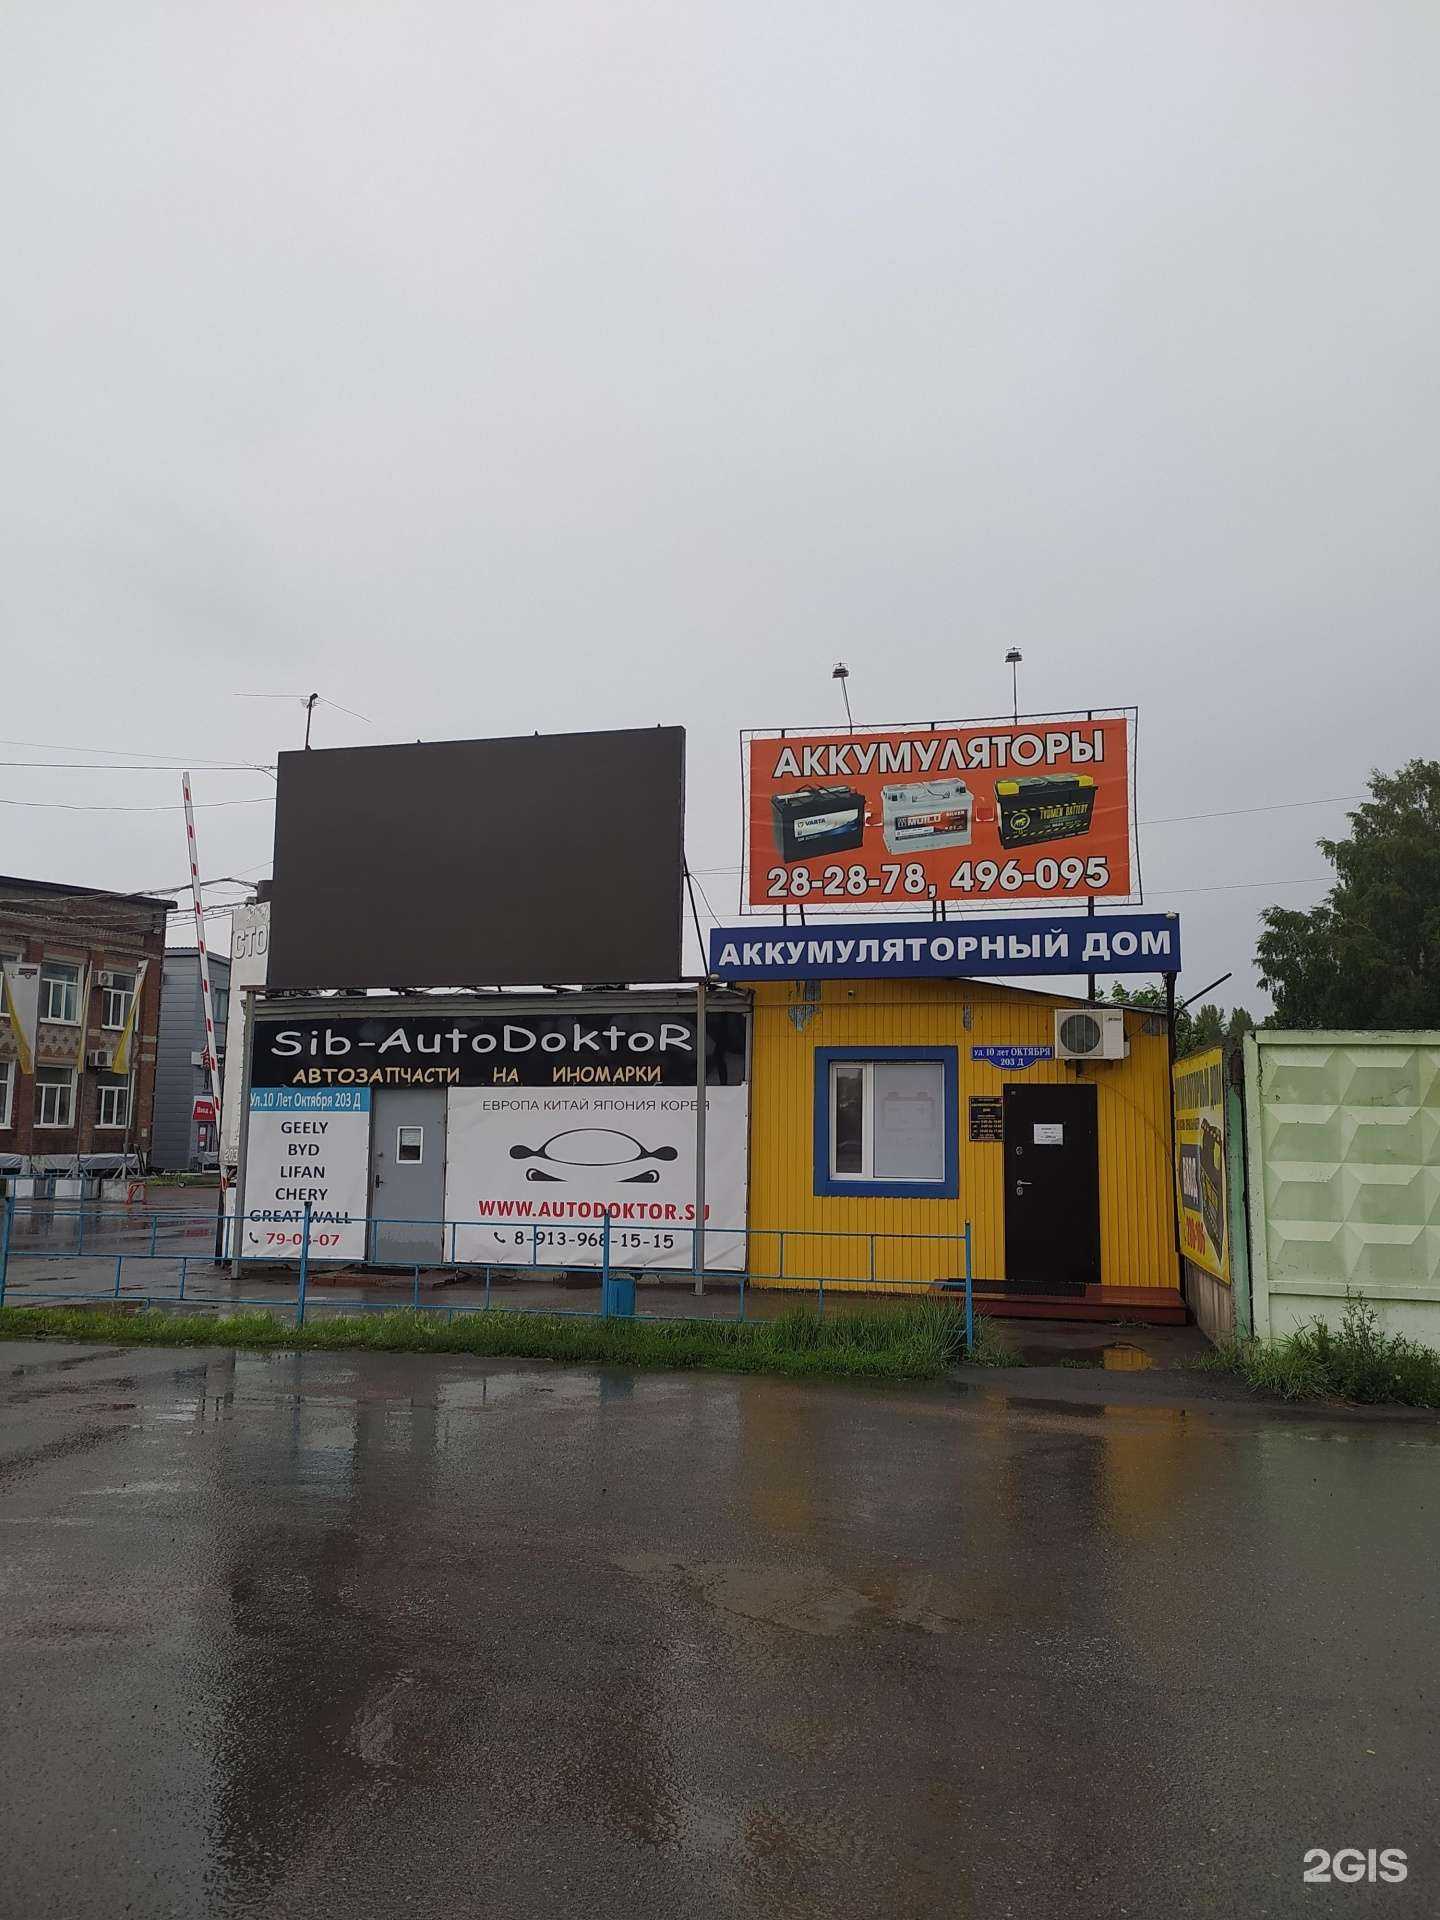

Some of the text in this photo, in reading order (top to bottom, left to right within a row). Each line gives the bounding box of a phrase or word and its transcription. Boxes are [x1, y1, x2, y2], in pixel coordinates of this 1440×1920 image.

[772, 729, 1104, 778] АККУМУЛЯТОРЫ
[805, 818, 826, 826] VARTA
[767, 856, 1109, 898] 28-28-78, 496-095
[233, 925, 269, 959] СТО
[719, 927, 1172, 966] АККУМУЛЯТОРНЫЙ ДОМ
[270, 1023, 693, 1057] Sib-AutoDoktoR
[986, 1048, 995, 1056] 10
[1010, 1048, 1051, 1056] ОКТЯБРЯ
[1000, 1058, 1015, 1066] 203
[292, 1065, 661, 1085] АВТОЗАПЧАСТИ НА ИНОМАРКИ
[275, 1092, 292, 1107] Лет
[295, 1091, 333, 1109] Октября
[335, 1092, 351, 1107] 203
[353, 1092, 361, 1108] Д
[482, 1100, 540, 1111] ЕВРОПА
[543, 1097, 589, 1111] КИТАЙ
[594, 1100, 656, 1111] ЯПОНИЯ
[281, 1121, 329, 1134] GEELY
[288, 1143, 320, 1156] BYD
[280, 1166, 326, 1178] LIFAN
[275, 1188, 328, 1201] CHERY
[250, 1209, 352, 1224] GREAT WALL
